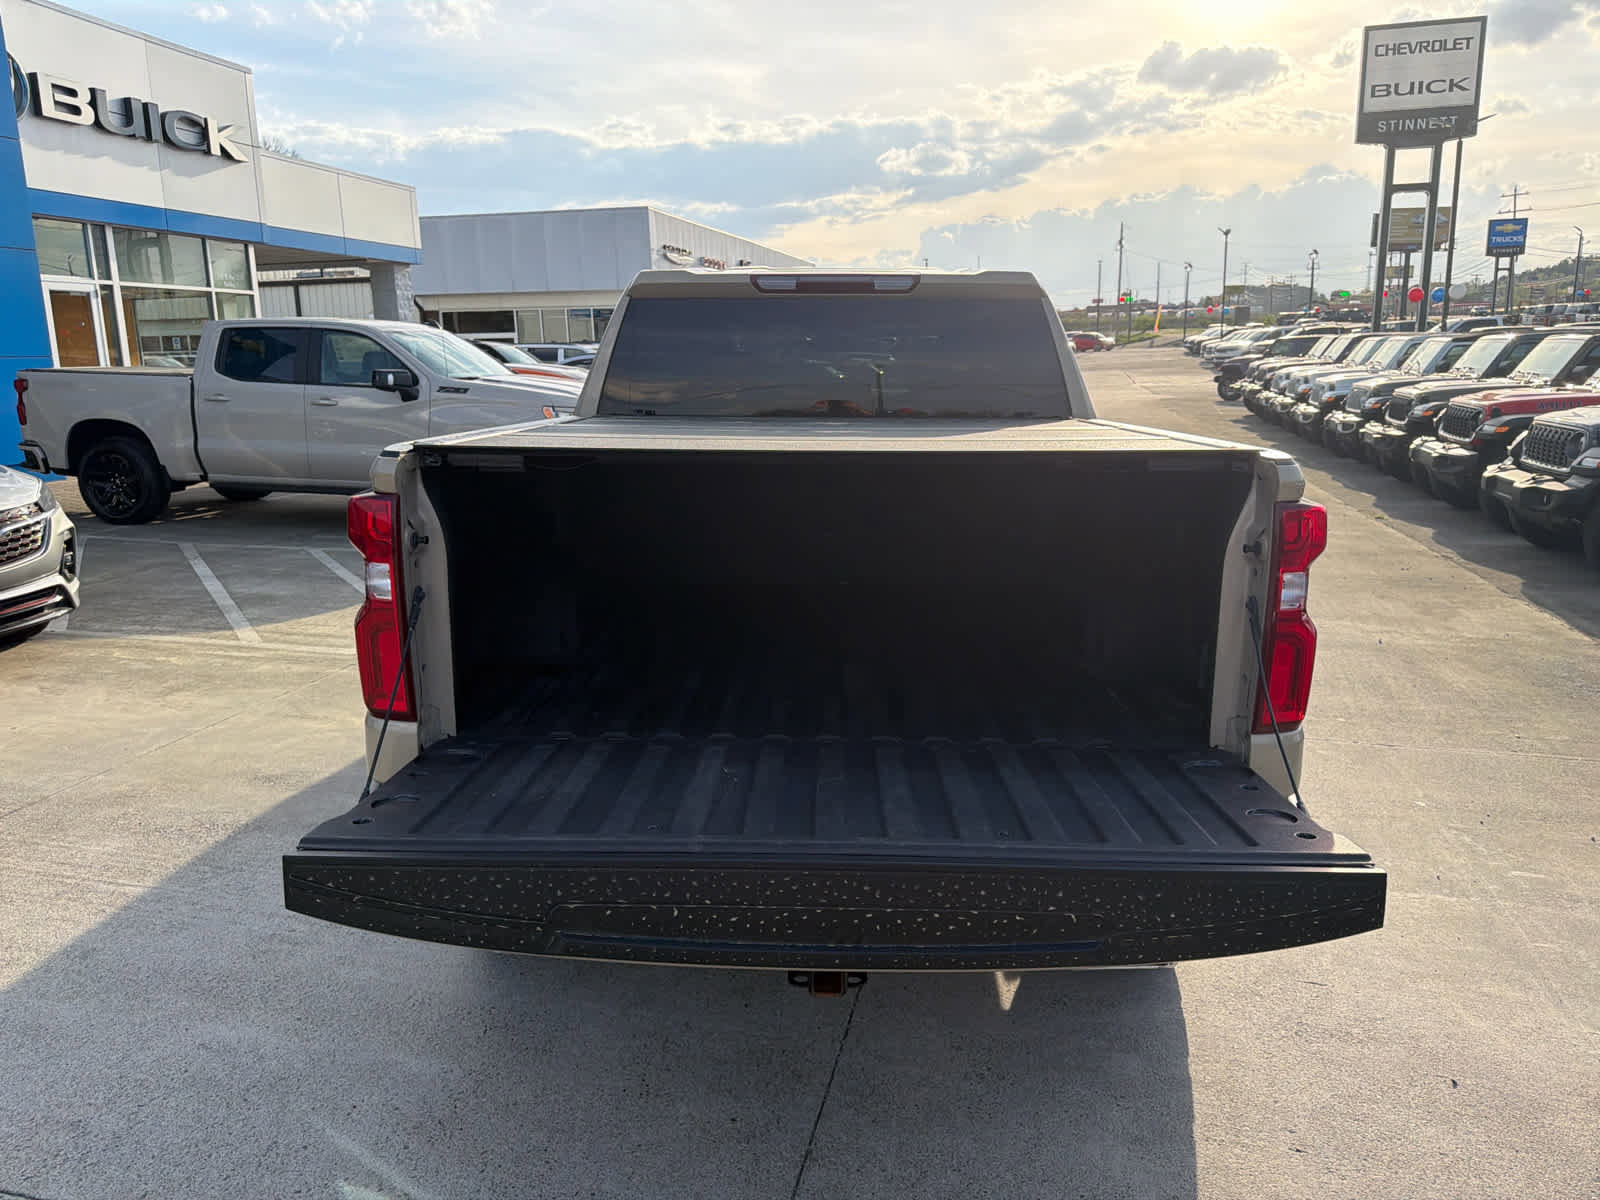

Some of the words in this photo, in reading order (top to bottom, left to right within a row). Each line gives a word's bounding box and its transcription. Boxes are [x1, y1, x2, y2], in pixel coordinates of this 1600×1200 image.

[1374, 36, 1474, 57] CHEVROLET
[1370, 76, 1471, 98] BUICK
[28, 72, 249, 162] BUICK
[1377, 115, 1458, 133] STINNETT
[1491, 235, 1524, 243] TRUCKS
